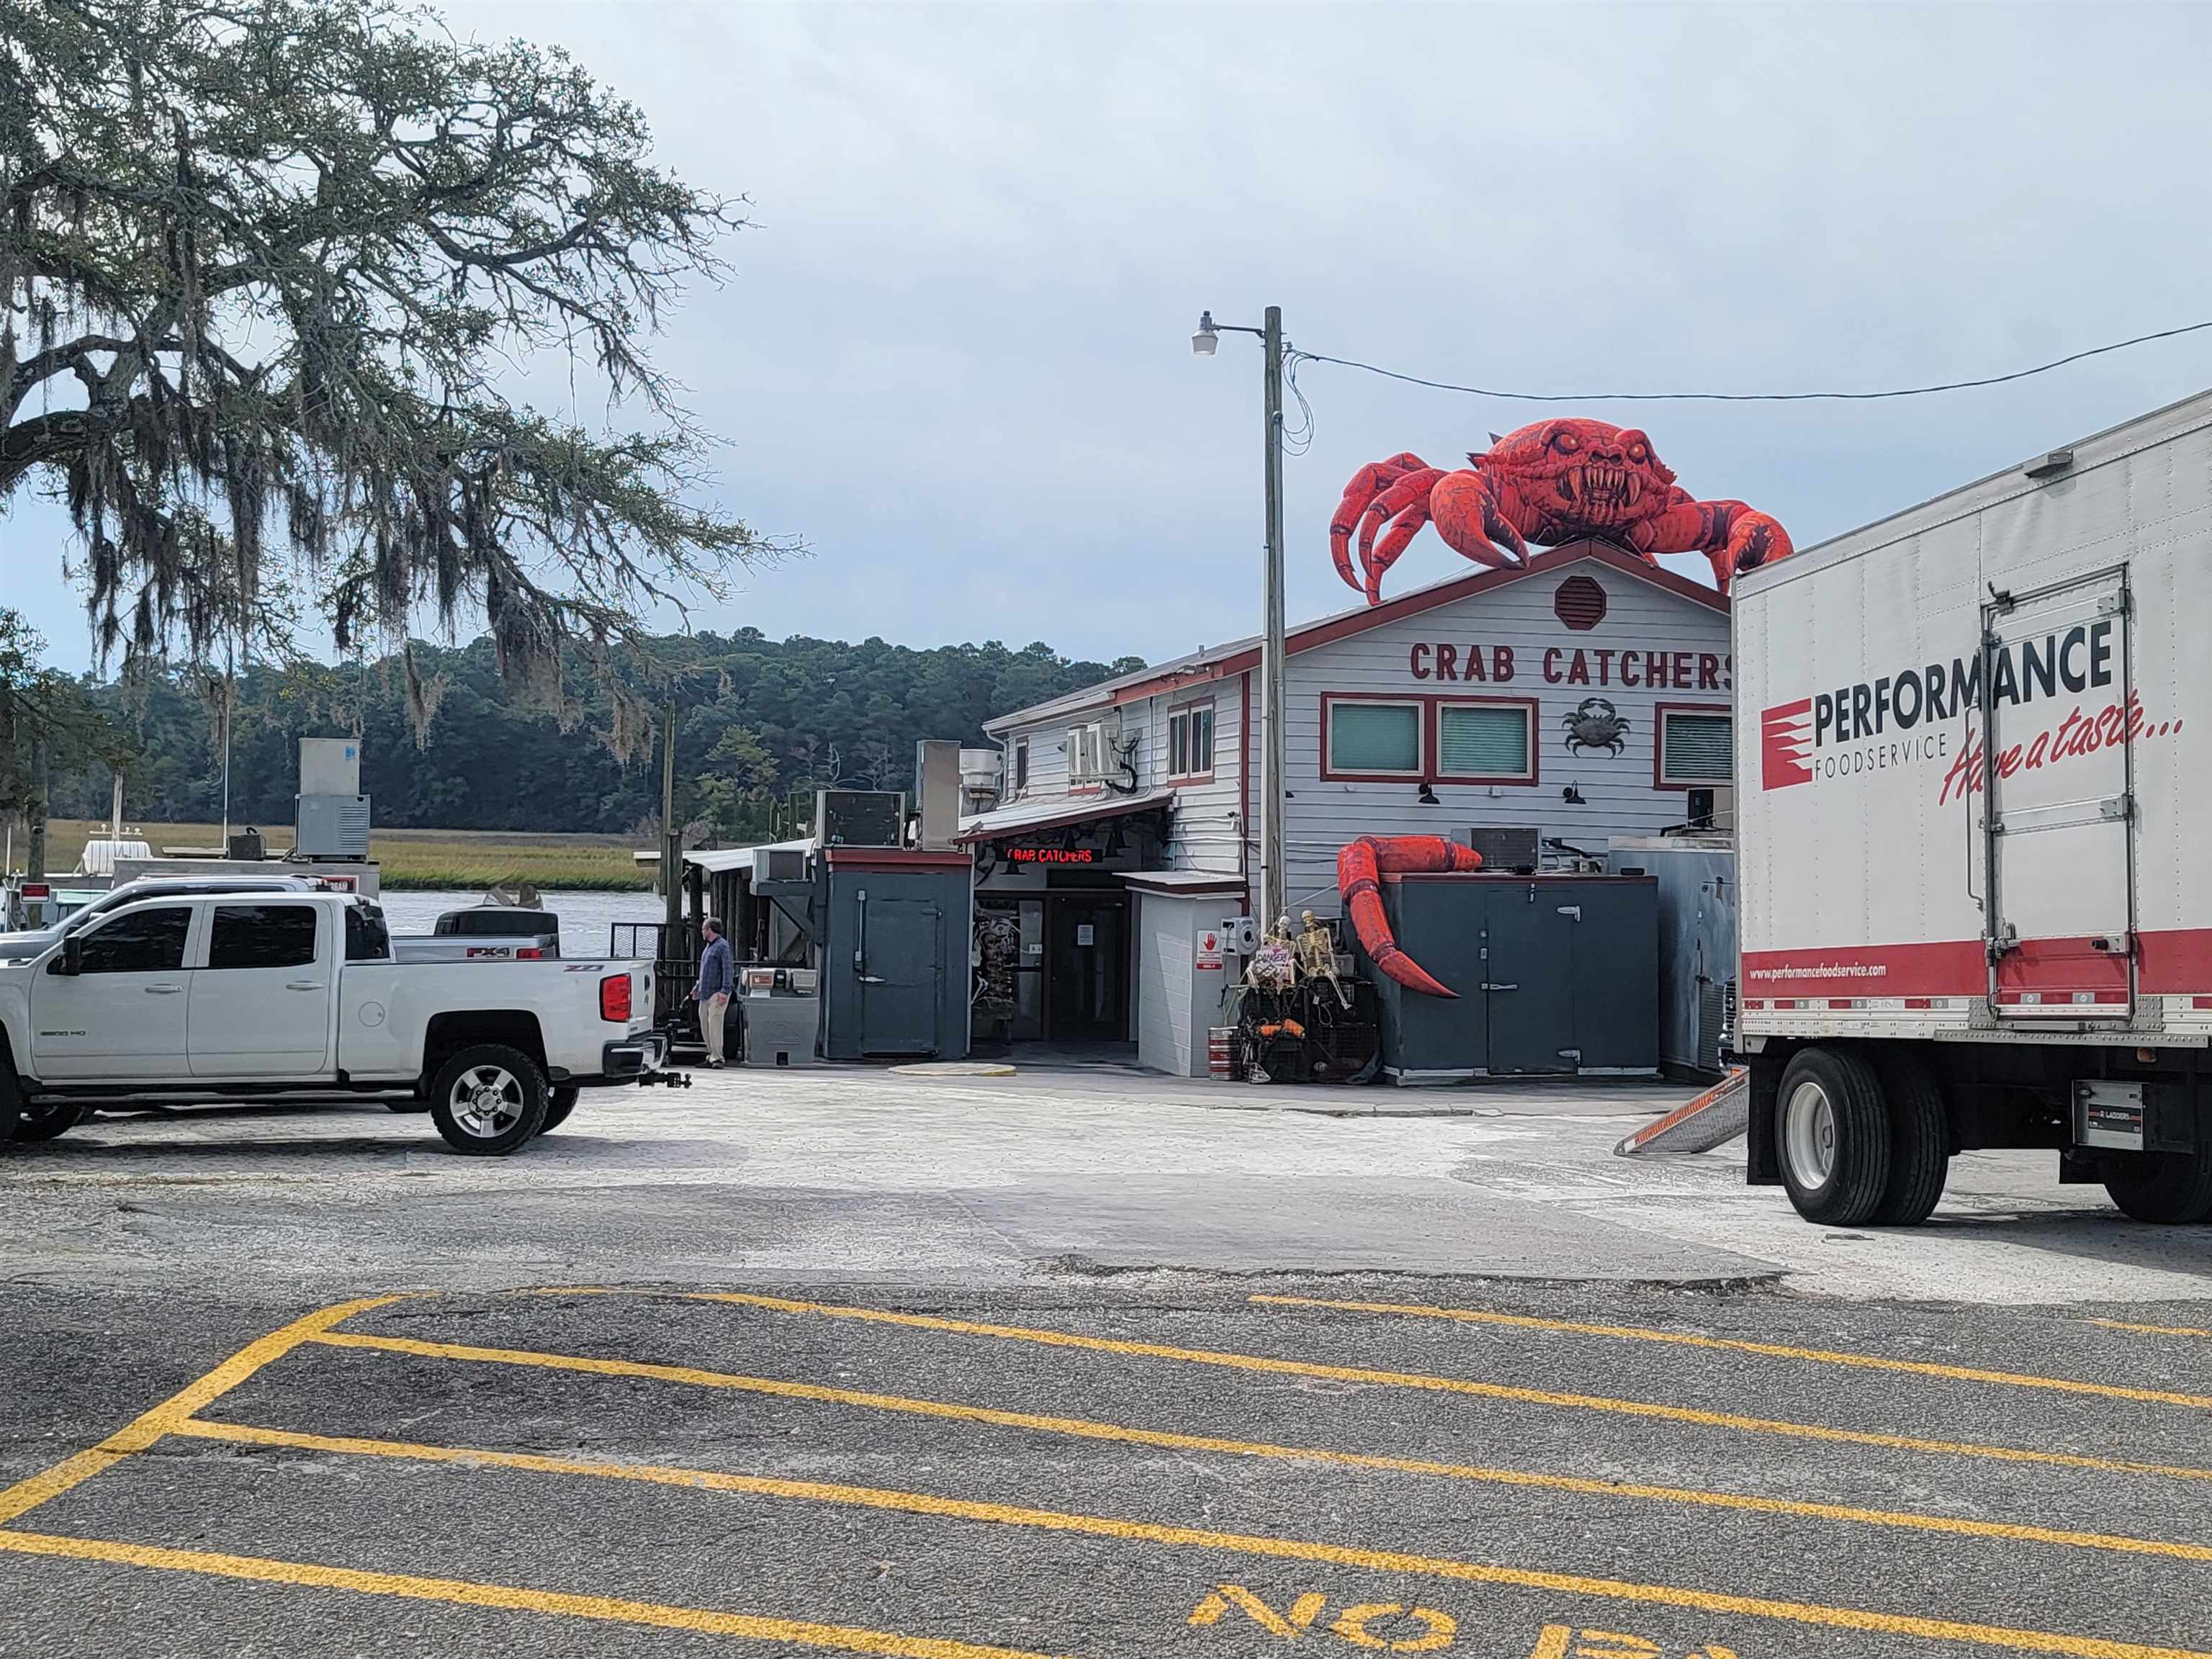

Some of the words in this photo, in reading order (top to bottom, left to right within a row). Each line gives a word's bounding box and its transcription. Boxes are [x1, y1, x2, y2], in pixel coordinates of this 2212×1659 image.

[1411, 642, 1514, 683] CRAB
[1815, 621, 2113, 748] PERFORMANCE
[1815, 733, 1947, 781] FOODSERVICE
[2024, 730, 2050, 770] a
[1038, 849, 1092, 863] CATCHERS
[467, 947, 511, 958] FX4
[1749, 961, 1887, 984] www.performancefoodservice.com
[1187, 1583, 1458, 1652] NO
